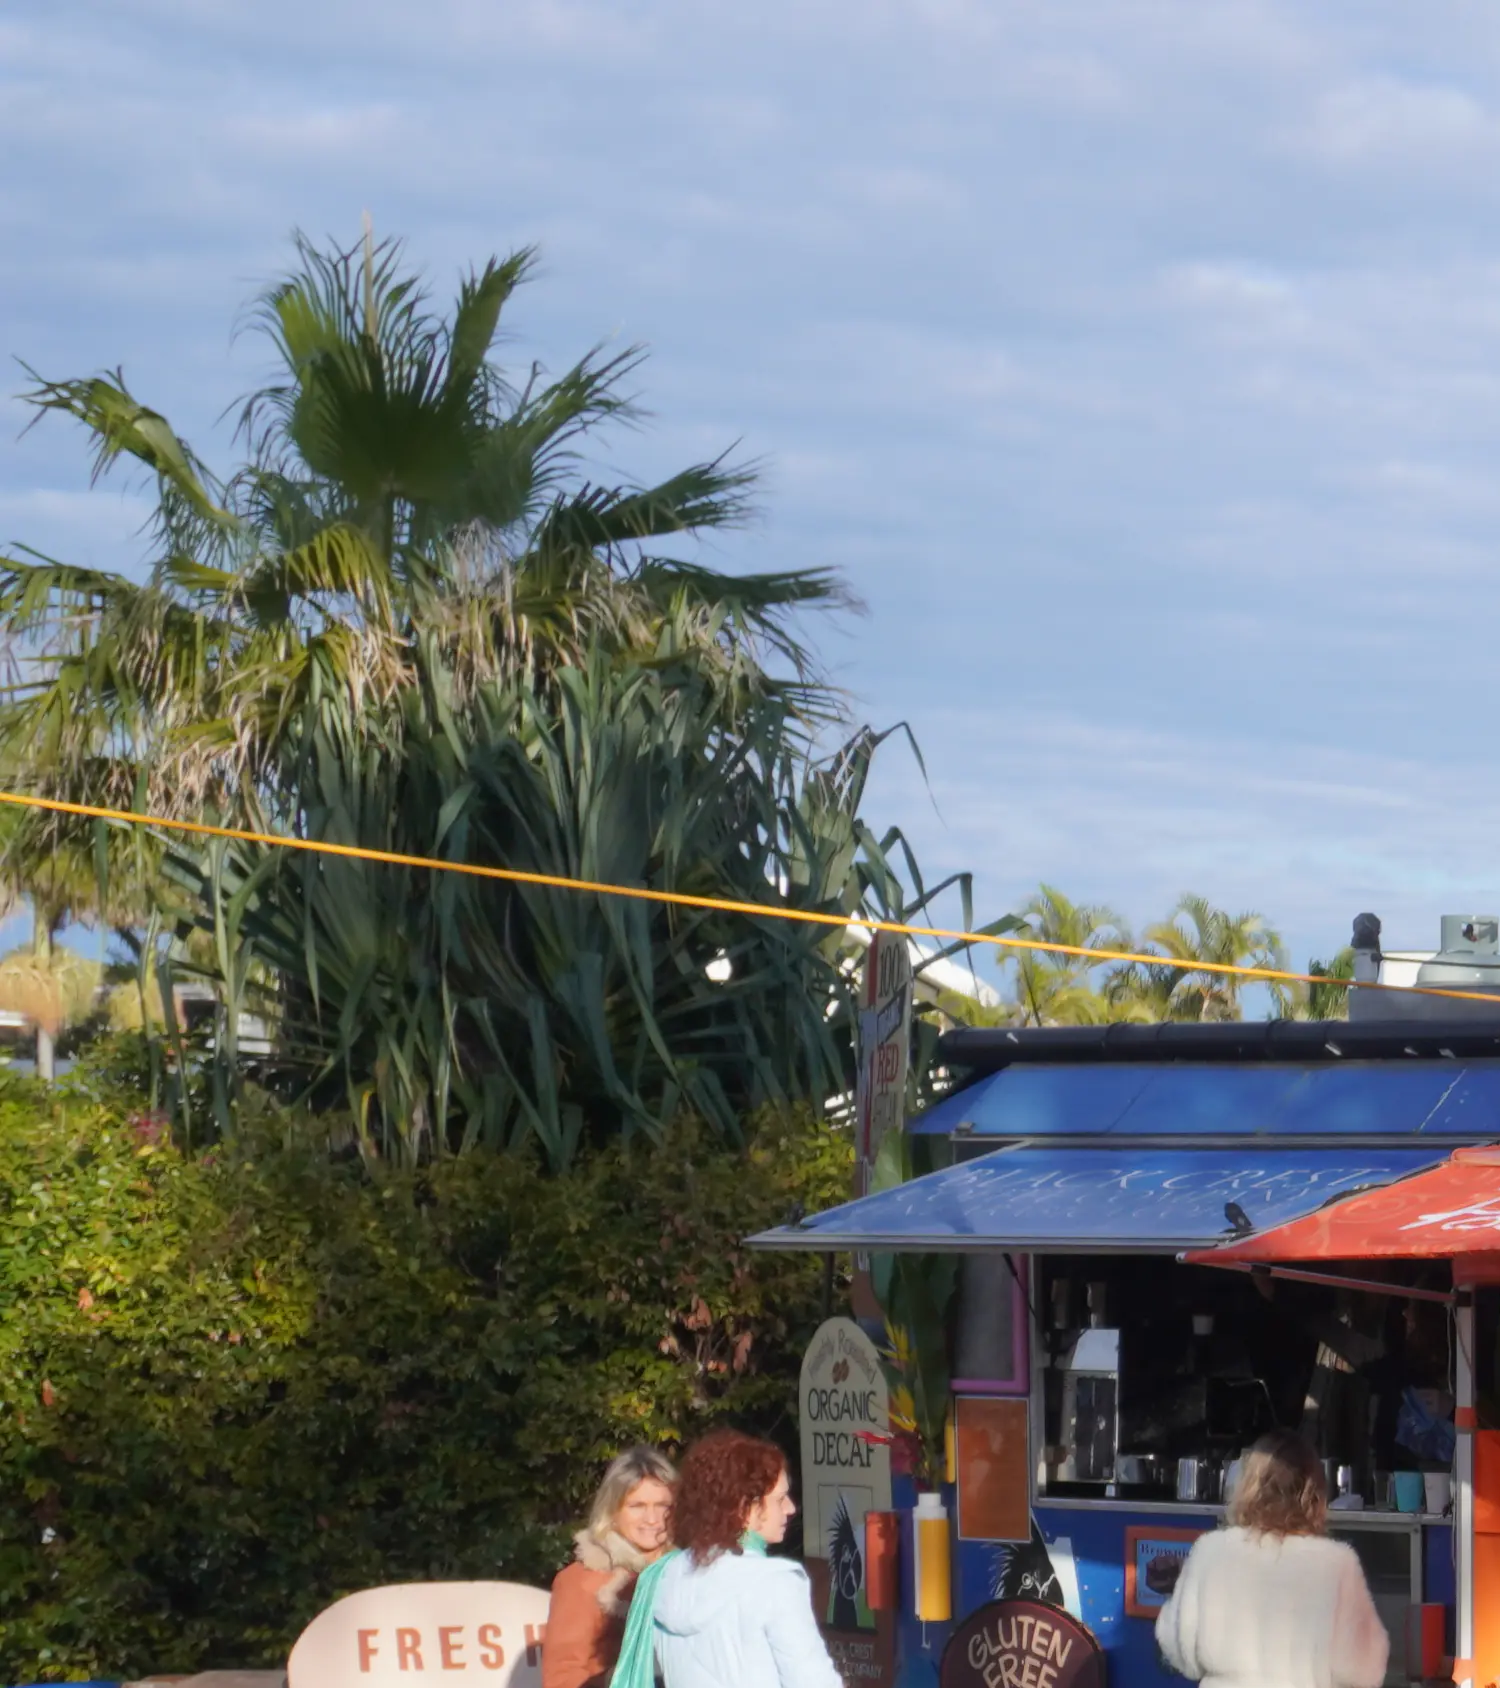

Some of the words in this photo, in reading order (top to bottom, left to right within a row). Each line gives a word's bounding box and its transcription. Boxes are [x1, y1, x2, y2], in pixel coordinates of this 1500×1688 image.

[808, 1387, 878, 1423] ORGANIC
[812, 1431, 876, 1468] DECAF
[968, 1615, 1073, 1669] GLUTEN
